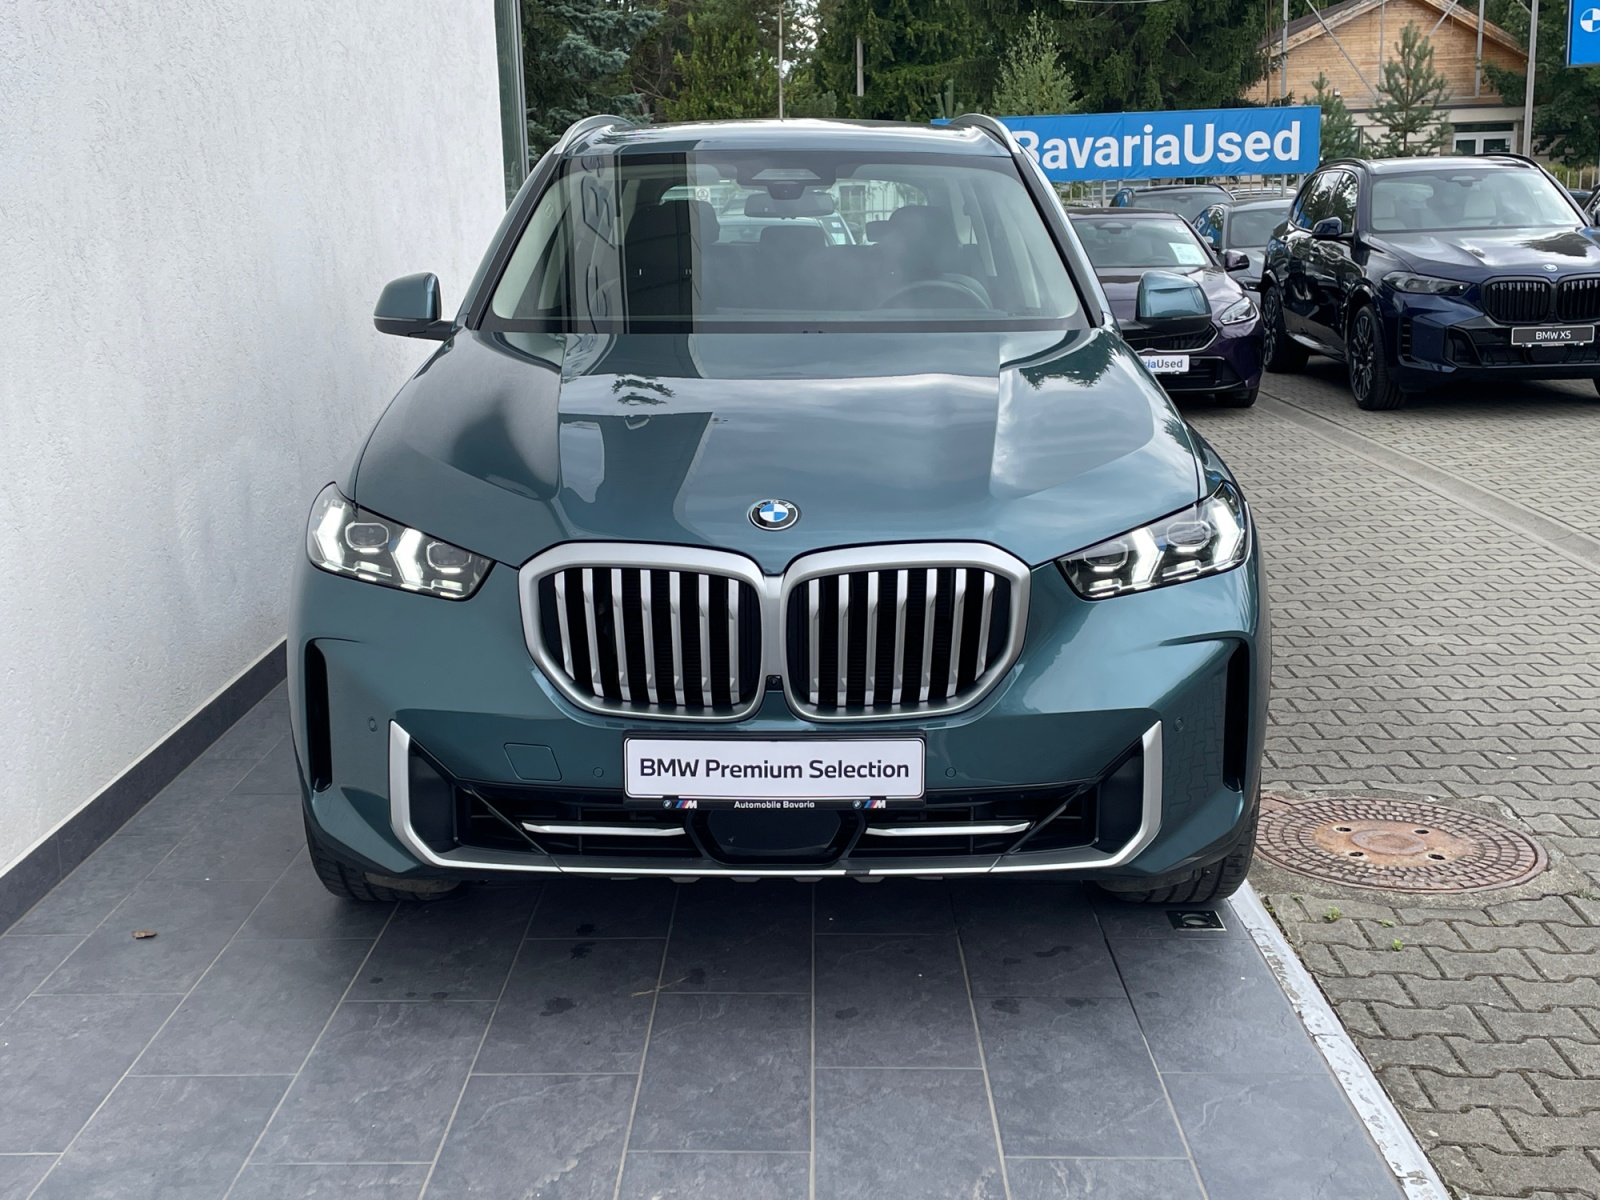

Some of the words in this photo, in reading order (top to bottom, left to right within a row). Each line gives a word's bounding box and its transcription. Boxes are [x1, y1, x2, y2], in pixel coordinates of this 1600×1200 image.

[1012, 120, 1301, 170] BavariaUsed
[1535, 331, 1559, 341] BMW
[1559, 330, 1572, 340] X5
[639, 758, 699, 778] BMW
[705, 759, 803, 779] Premium
[808, 759, 910, 779] Selection
[733, 800, 781, 809] Automobile
[783, 800, 815, 809] Bavaria
